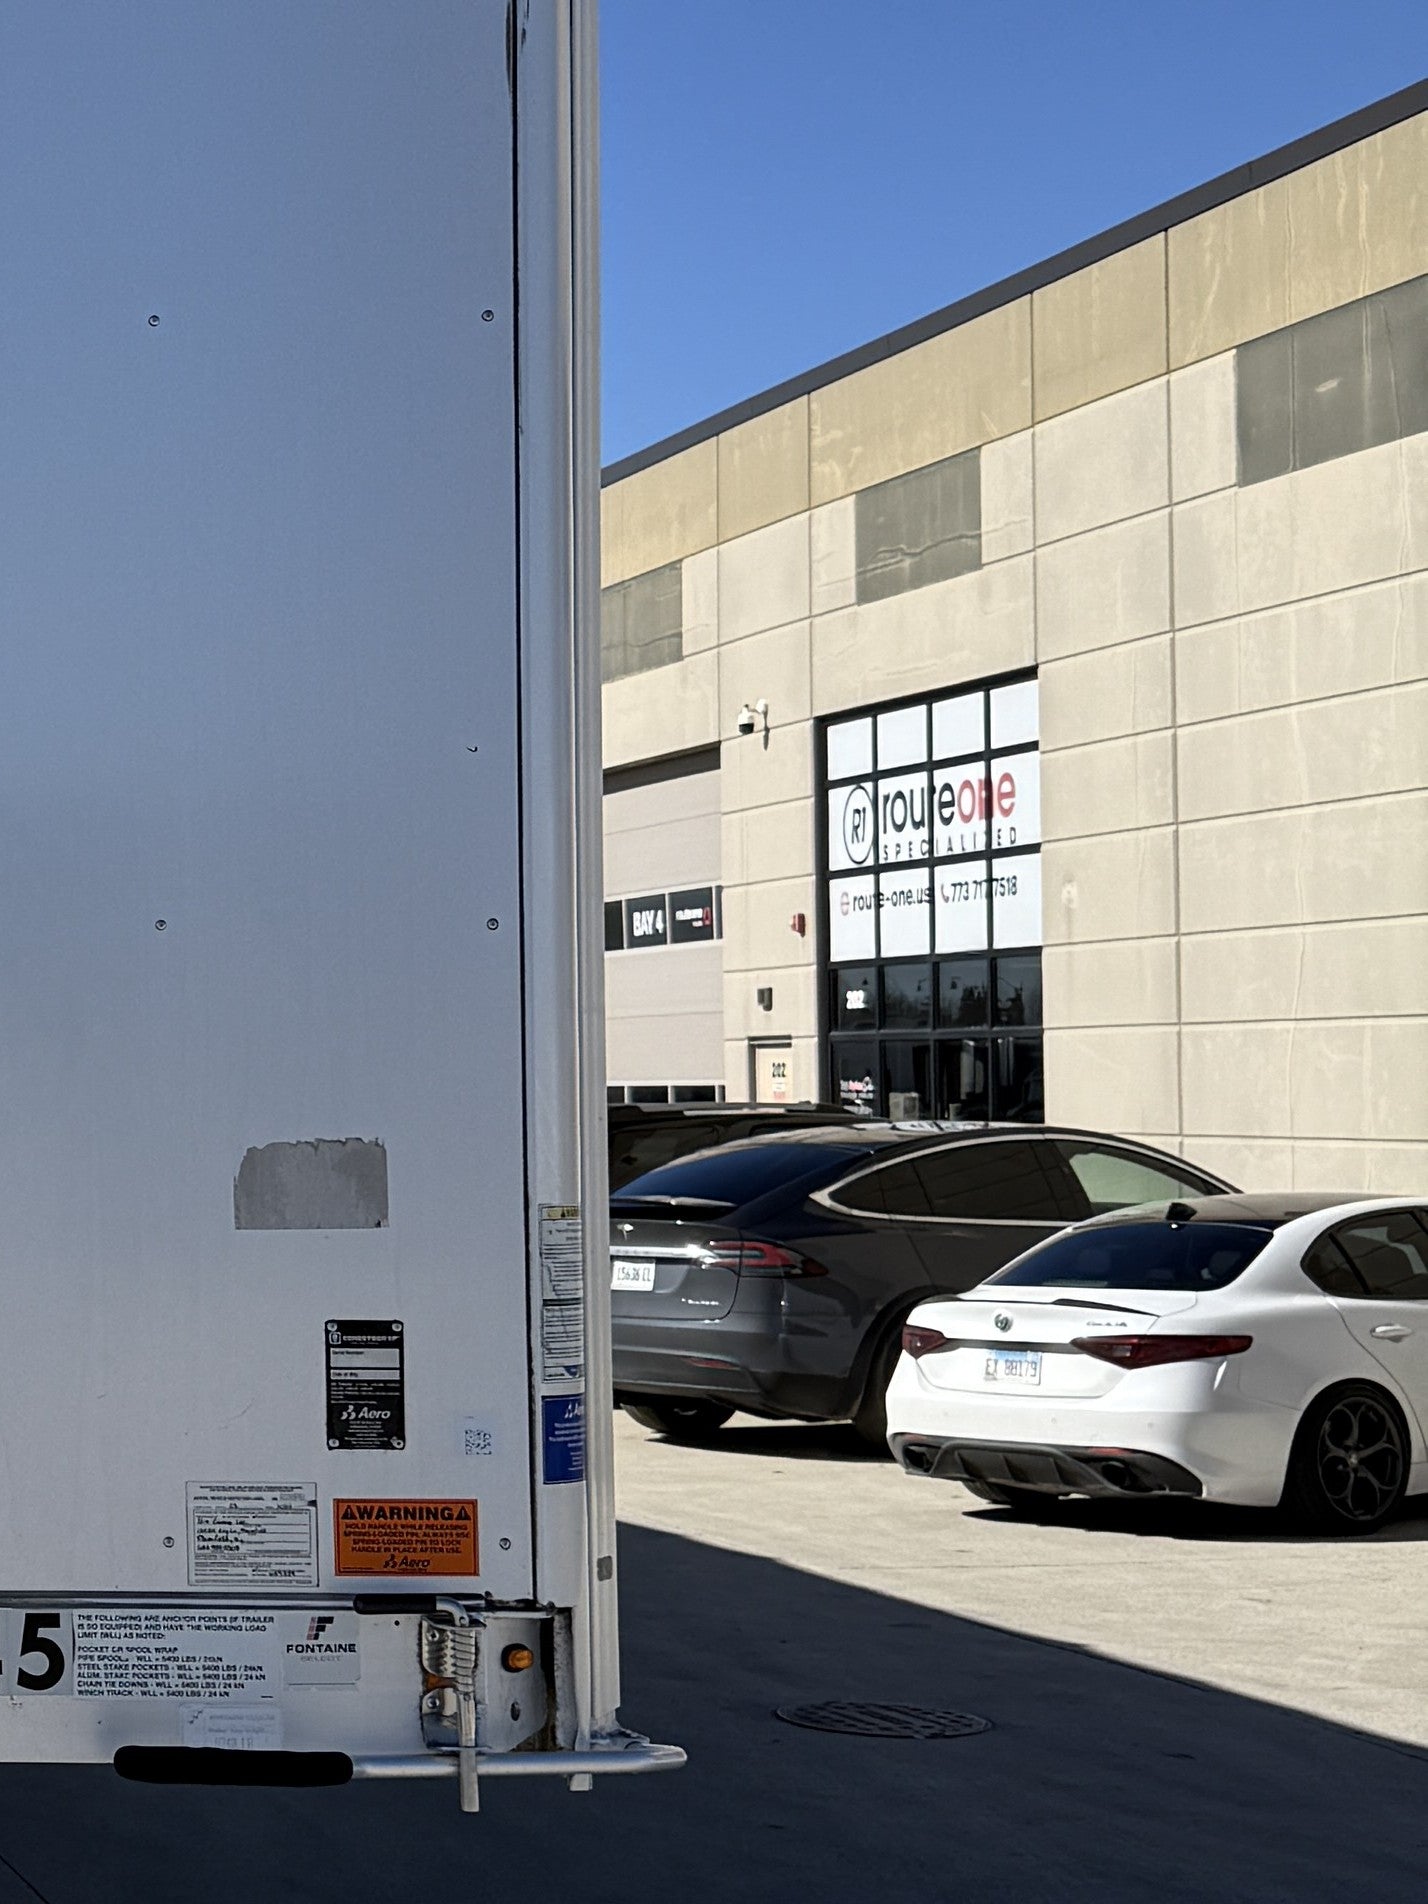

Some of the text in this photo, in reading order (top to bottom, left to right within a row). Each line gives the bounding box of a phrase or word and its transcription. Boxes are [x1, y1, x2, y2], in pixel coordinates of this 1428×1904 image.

[883, 827, 1016, 861] SPECIALIED
[951, 881, 970, 902] 773
[633, 910, 655, 936] BAY
[656, 910, 664, 933] 4
[358, 1407, 391, 1419] Aero
[356, 1506, 454, 1520] WARNING
[399, 1556, 430, 1568] Aero
[287, 1644, 356, 1654] FONTAINE
